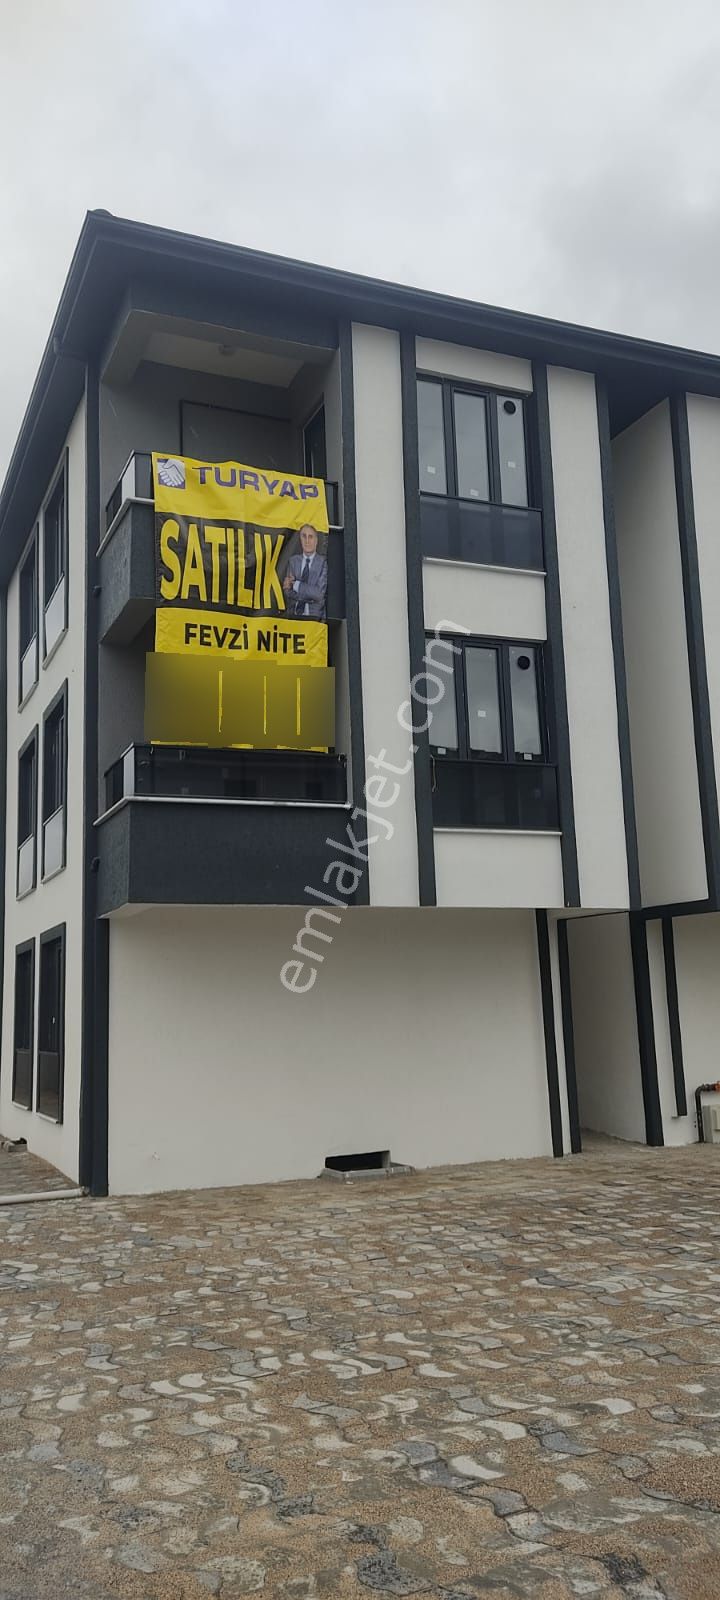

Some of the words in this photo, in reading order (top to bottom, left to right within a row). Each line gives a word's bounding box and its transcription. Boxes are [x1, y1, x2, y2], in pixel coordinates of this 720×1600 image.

[192, 466, 319, 500] TURYAP
[160, 519, 286, 610] SATILIK
[184, 623, 248, 650] FEVZİ
[257, 625, 306, 654] NİTE
